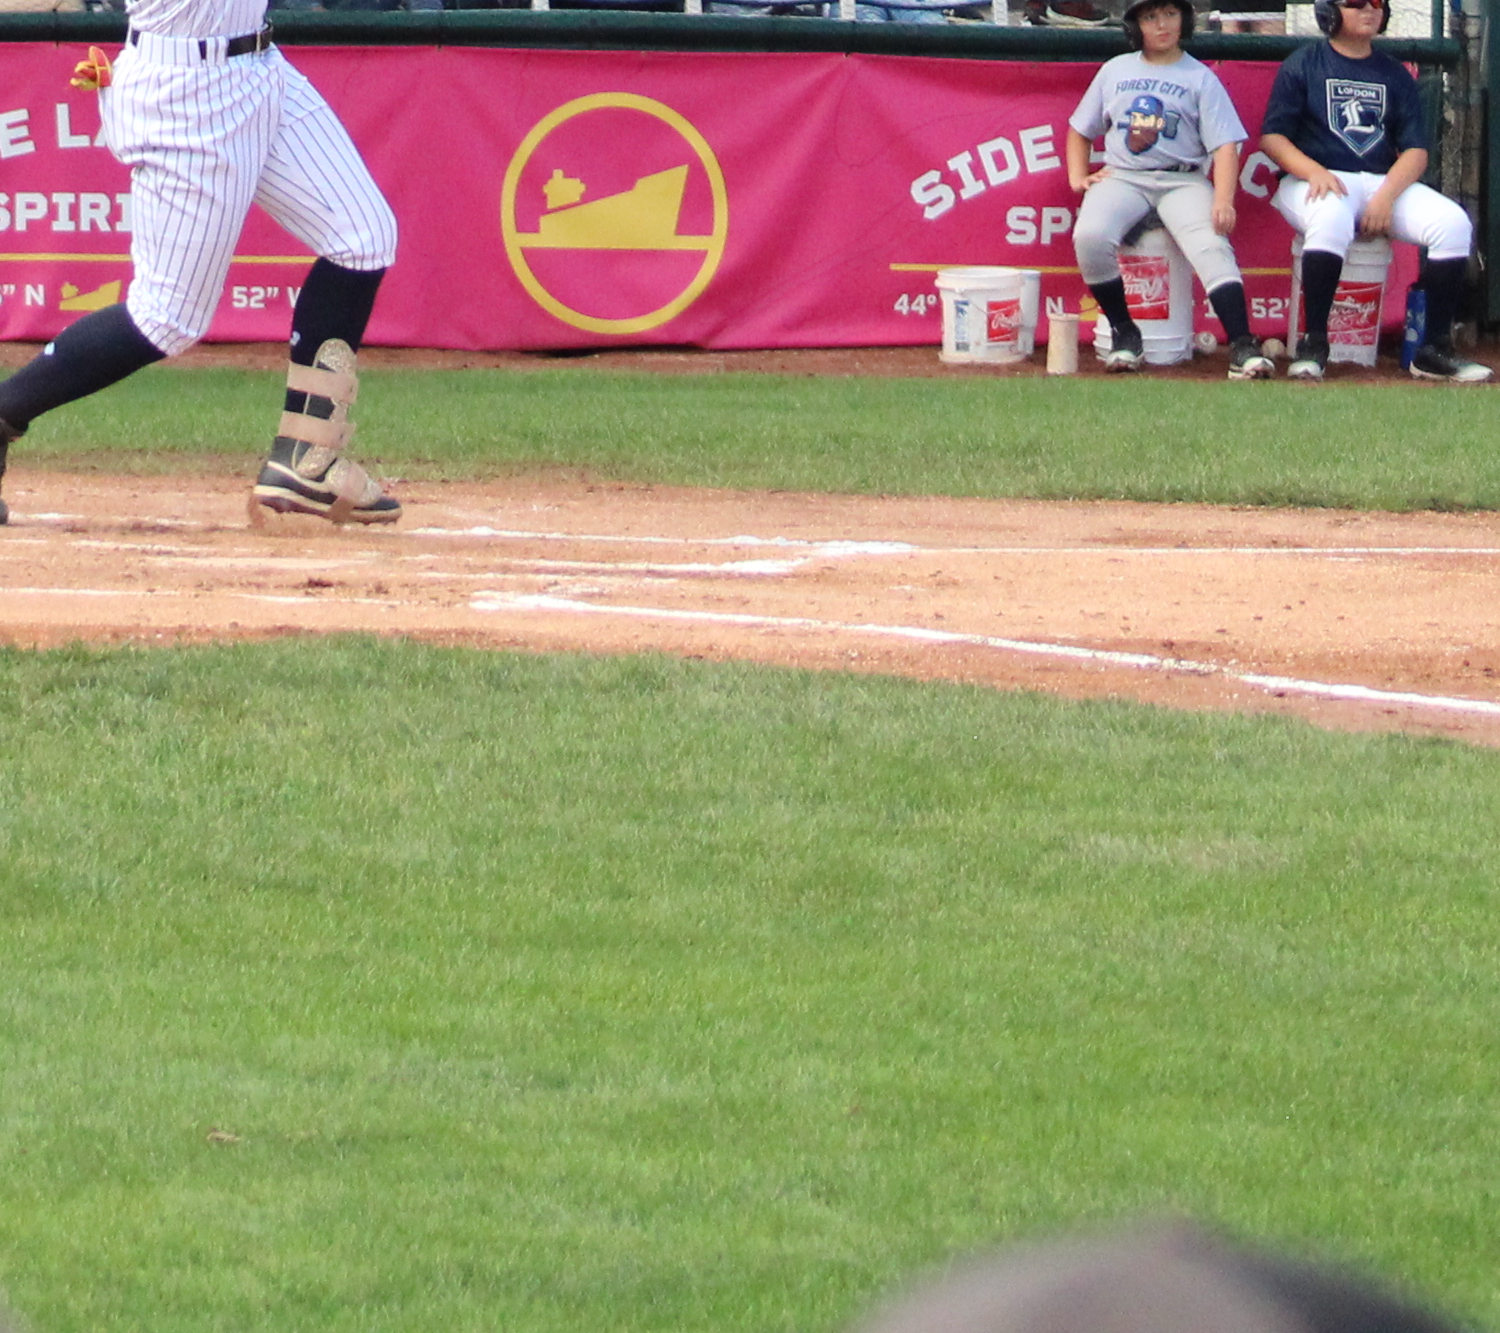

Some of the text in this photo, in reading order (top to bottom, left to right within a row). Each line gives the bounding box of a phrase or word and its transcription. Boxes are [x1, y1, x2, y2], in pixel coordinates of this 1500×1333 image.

[1116, 78, 1188, 100] FOREST CITY
[1337, 86, 1376, 100] LONDON
[909, 123, 1061, 221] SIDE
[25, 285, 45, 307] N
[1045, 296, 1064, 317] N
